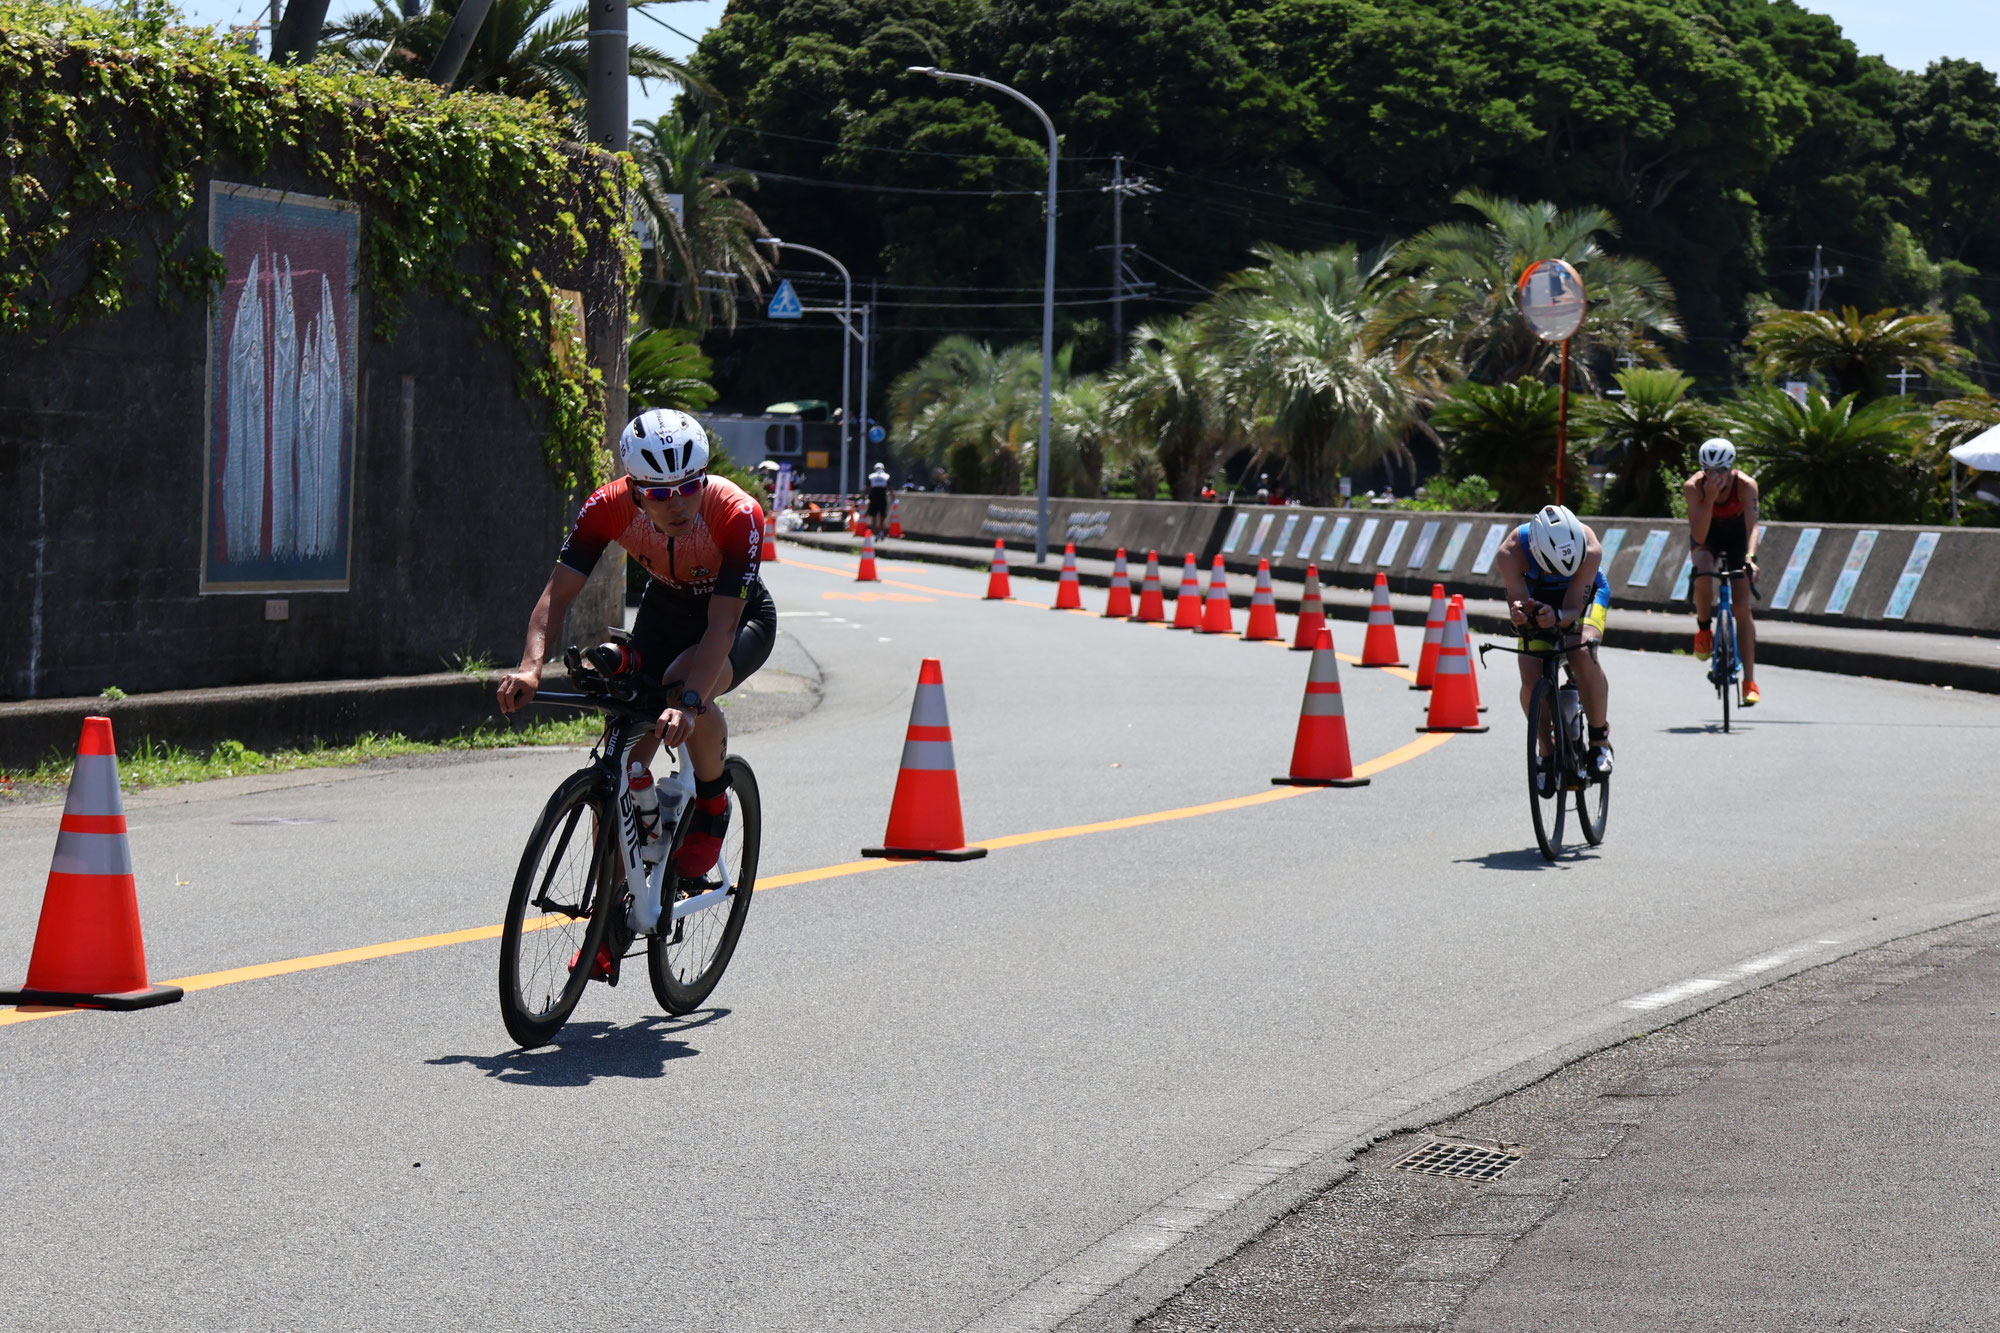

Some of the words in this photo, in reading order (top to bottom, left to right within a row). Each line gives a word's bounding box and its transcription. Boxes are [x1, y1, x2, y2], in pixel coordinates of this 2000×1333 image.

[659, 435, 673, 445] 10
[1561, 548, 1572, 556] 39
[606, 727, 620, 757] BMC
[619, 790, 642, 870] BMC
